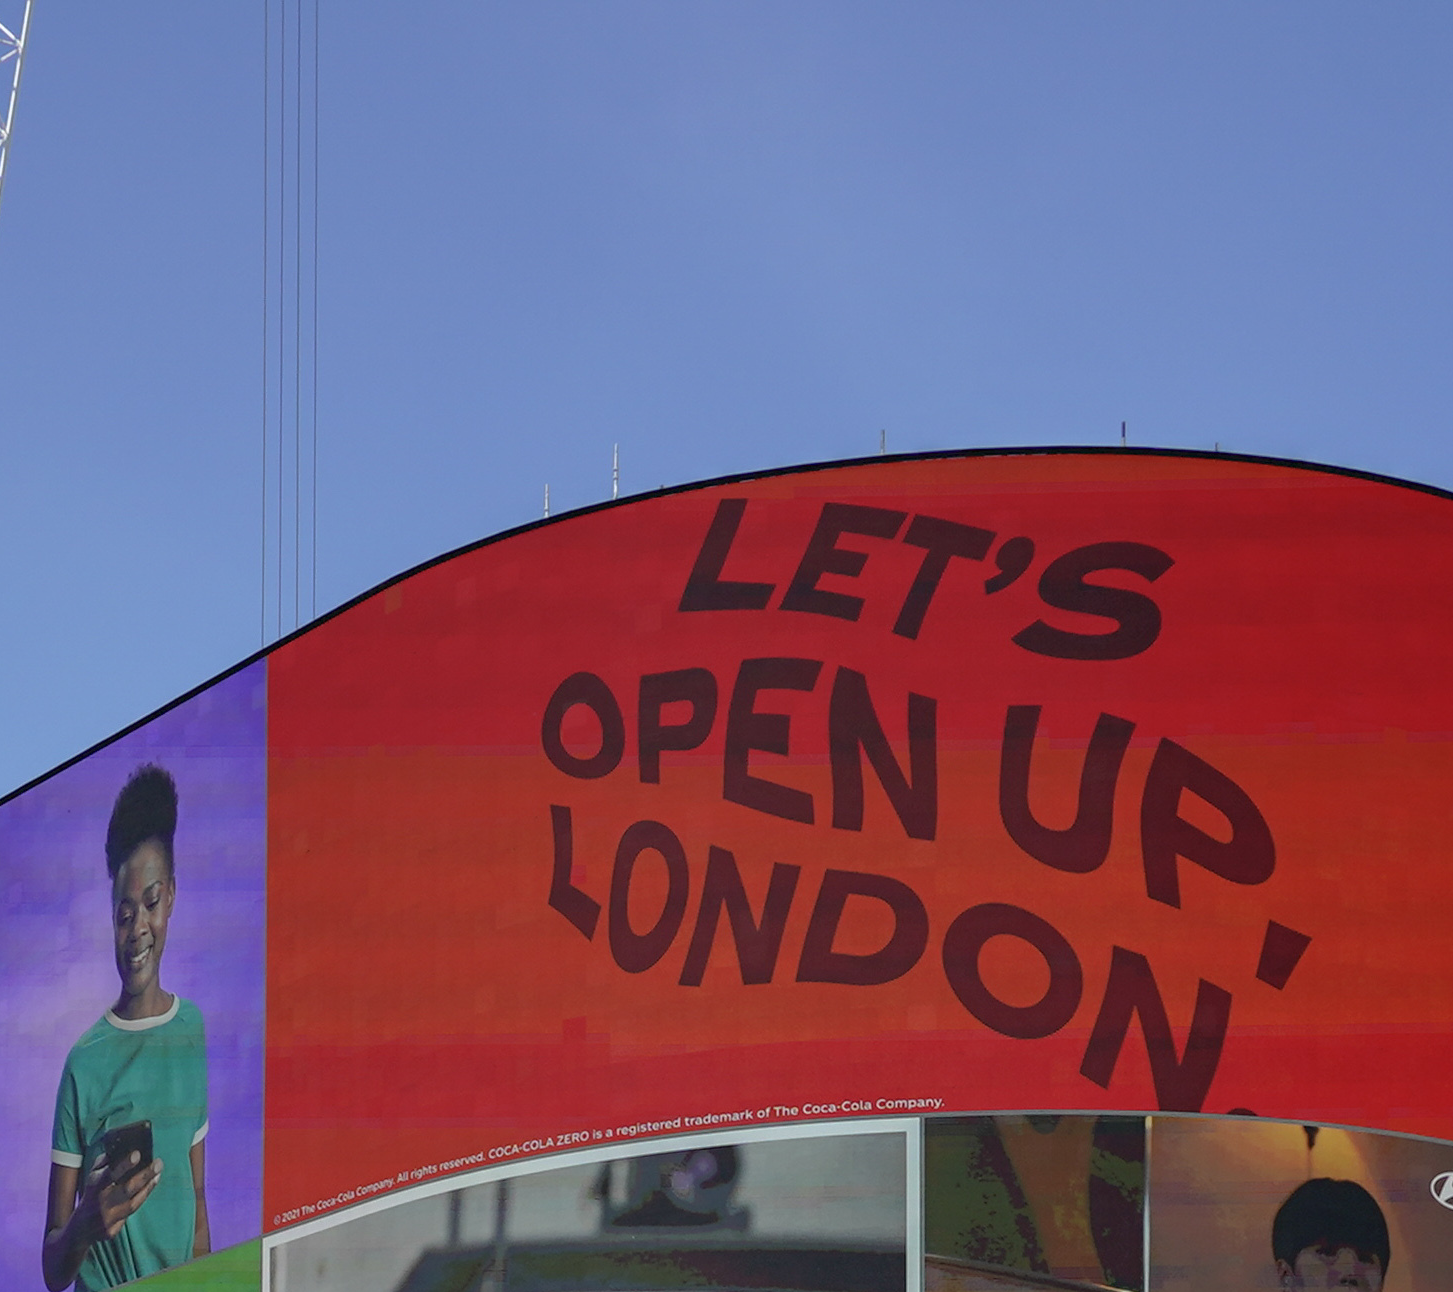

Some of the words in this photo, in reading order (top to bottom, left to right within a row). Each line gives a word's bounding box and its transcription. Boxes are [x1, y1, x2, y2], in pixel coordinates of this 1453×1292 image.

[676, 496, 1176, 663] LET'S
[540, 655, 939, 842] OPEN
[547, 804, 1259, 1116] LONDON
[282, 1209, 301, 1224] 2021
[301, 1203, 316, 1217] The
[317, 1189, 355, 1213] Coca-Cola
[356, 1176, 395, 1199] Company.
[396, 1168, 409, 1184] All
[410, 1162, 438, 1183] rights
[439, 1151, 486, 1173] reserved.
[488, 1137, 555, 1160] COCA-COLA
[556, 1129, 590, 1148] ZERO
[593, 1128, 603, 1140] is
[604, 1128, 615, 1139] a
[616, 1114, 682, 1137] registered
[684, 1108, 754, 1128] trademark
[756, 1105, 771, 1120] of
[773, 1103, 799, 1118] The
[802, 1098, 872, 1116] Coca-Cola
[876, 1095, 946, 1113] Company.
